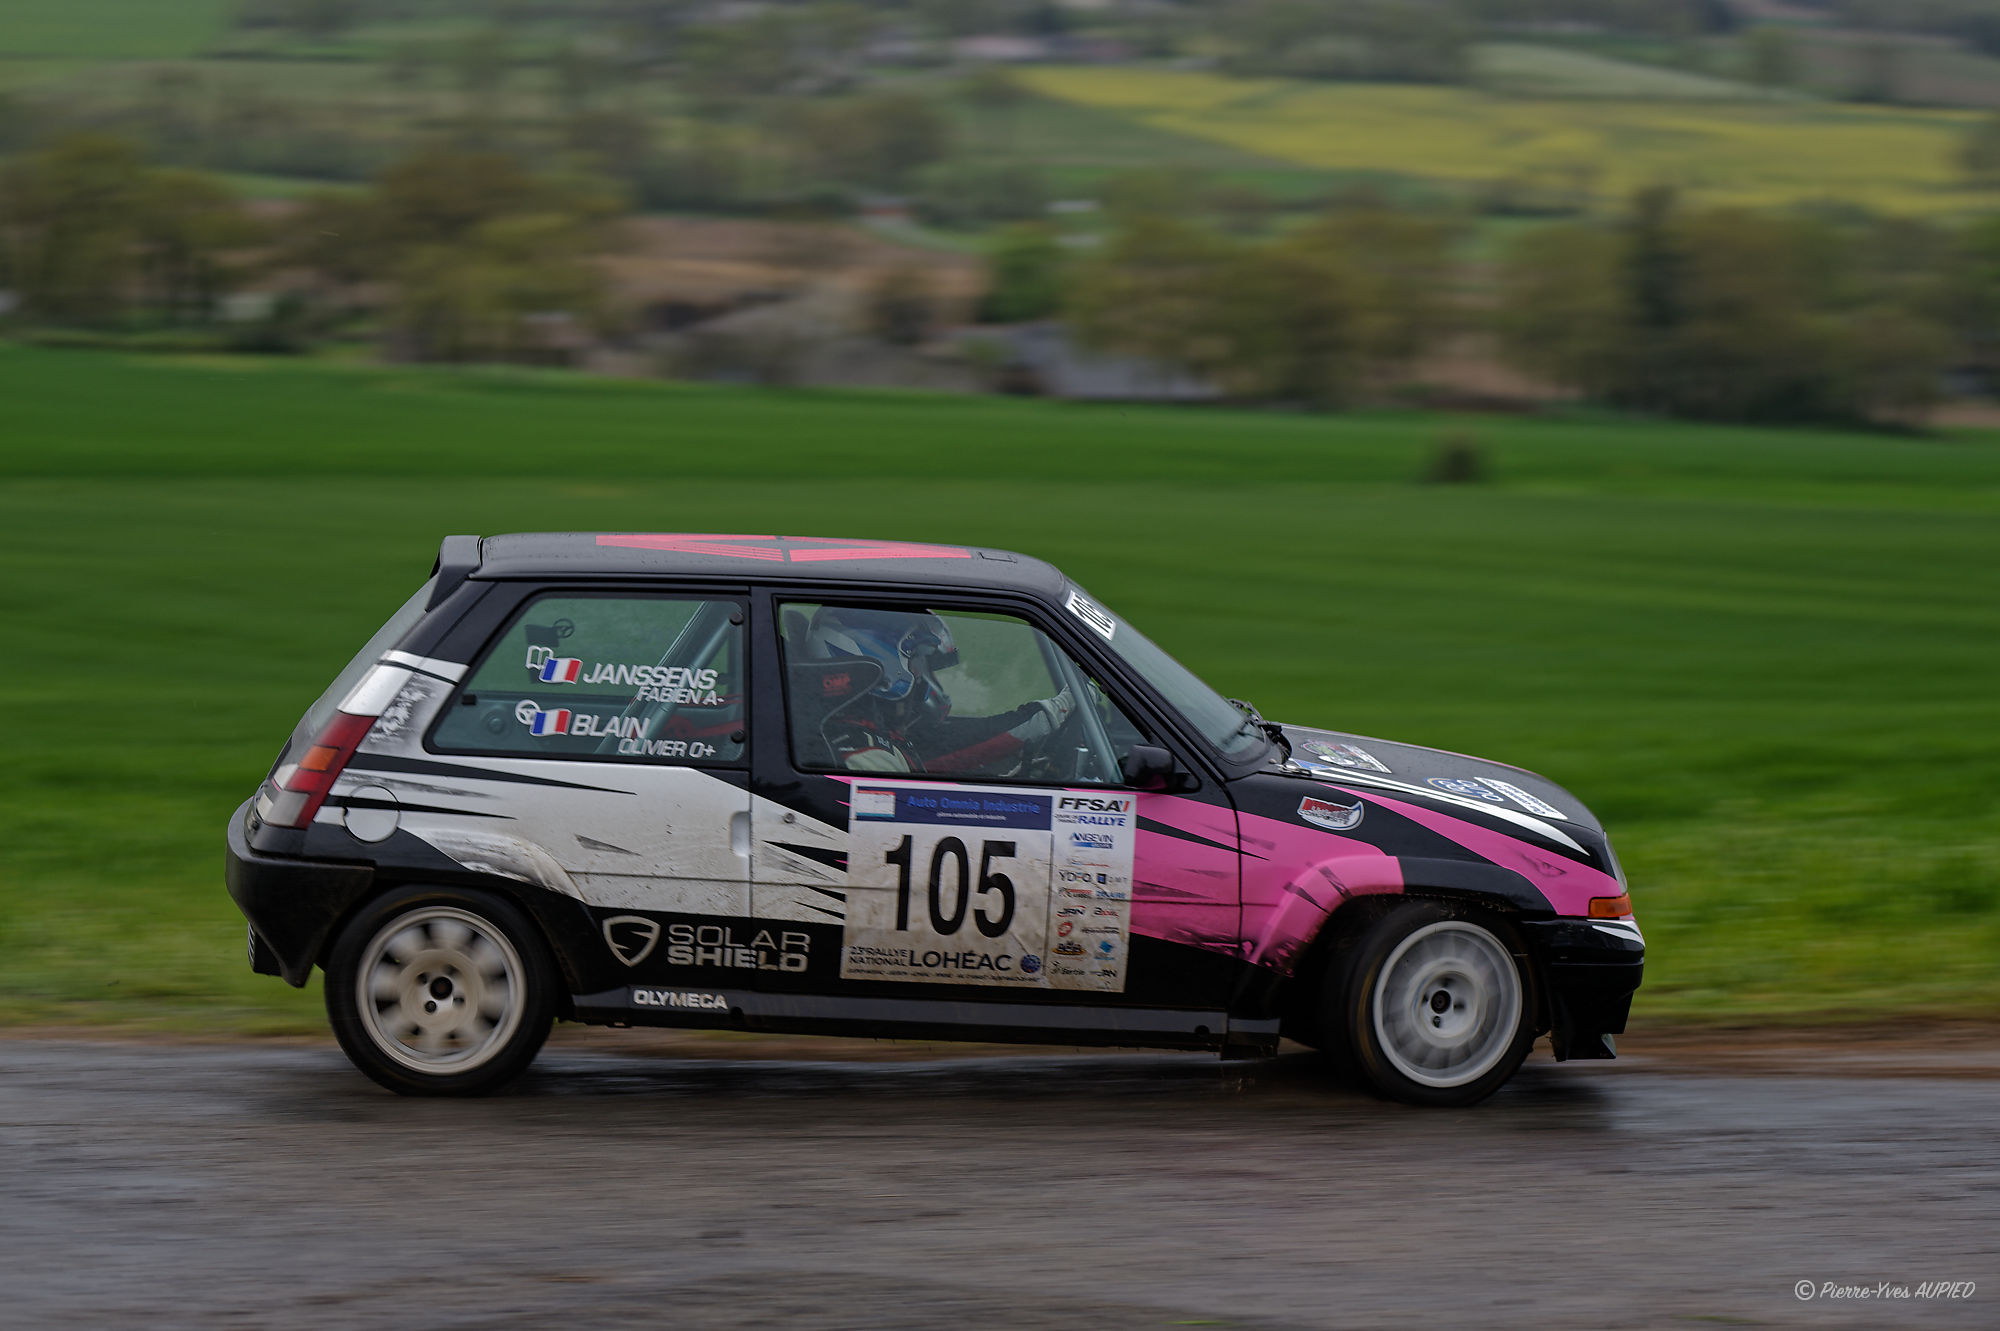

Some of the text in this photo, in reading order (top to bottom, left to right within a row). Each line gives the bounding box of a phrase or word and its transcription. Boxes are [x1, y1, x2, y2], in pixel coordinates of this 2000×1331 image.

[583, 663, 718, 690] JANSSENS
[636, 686, 725, 706] FABIEN A-
[571, 714, 650, 739] BLAIN
[618, 738, 716, 758] OLIVIER O+
[907, 795, 937, 808] Auto
[983, 799, 1040, 815] Industrie
[1059, 797, 1121, 813] FFSA
[1077, 815, 1126, 827] RALLYE
[886, 834, 1016, 939] 105
[668, 924, 811, 953] SOLAR
[667, 945, 809, 973] SHIELD
[849, 955, 908, 967] NATIONAL
[909, 949, 1012, 972] LOHÉAC
